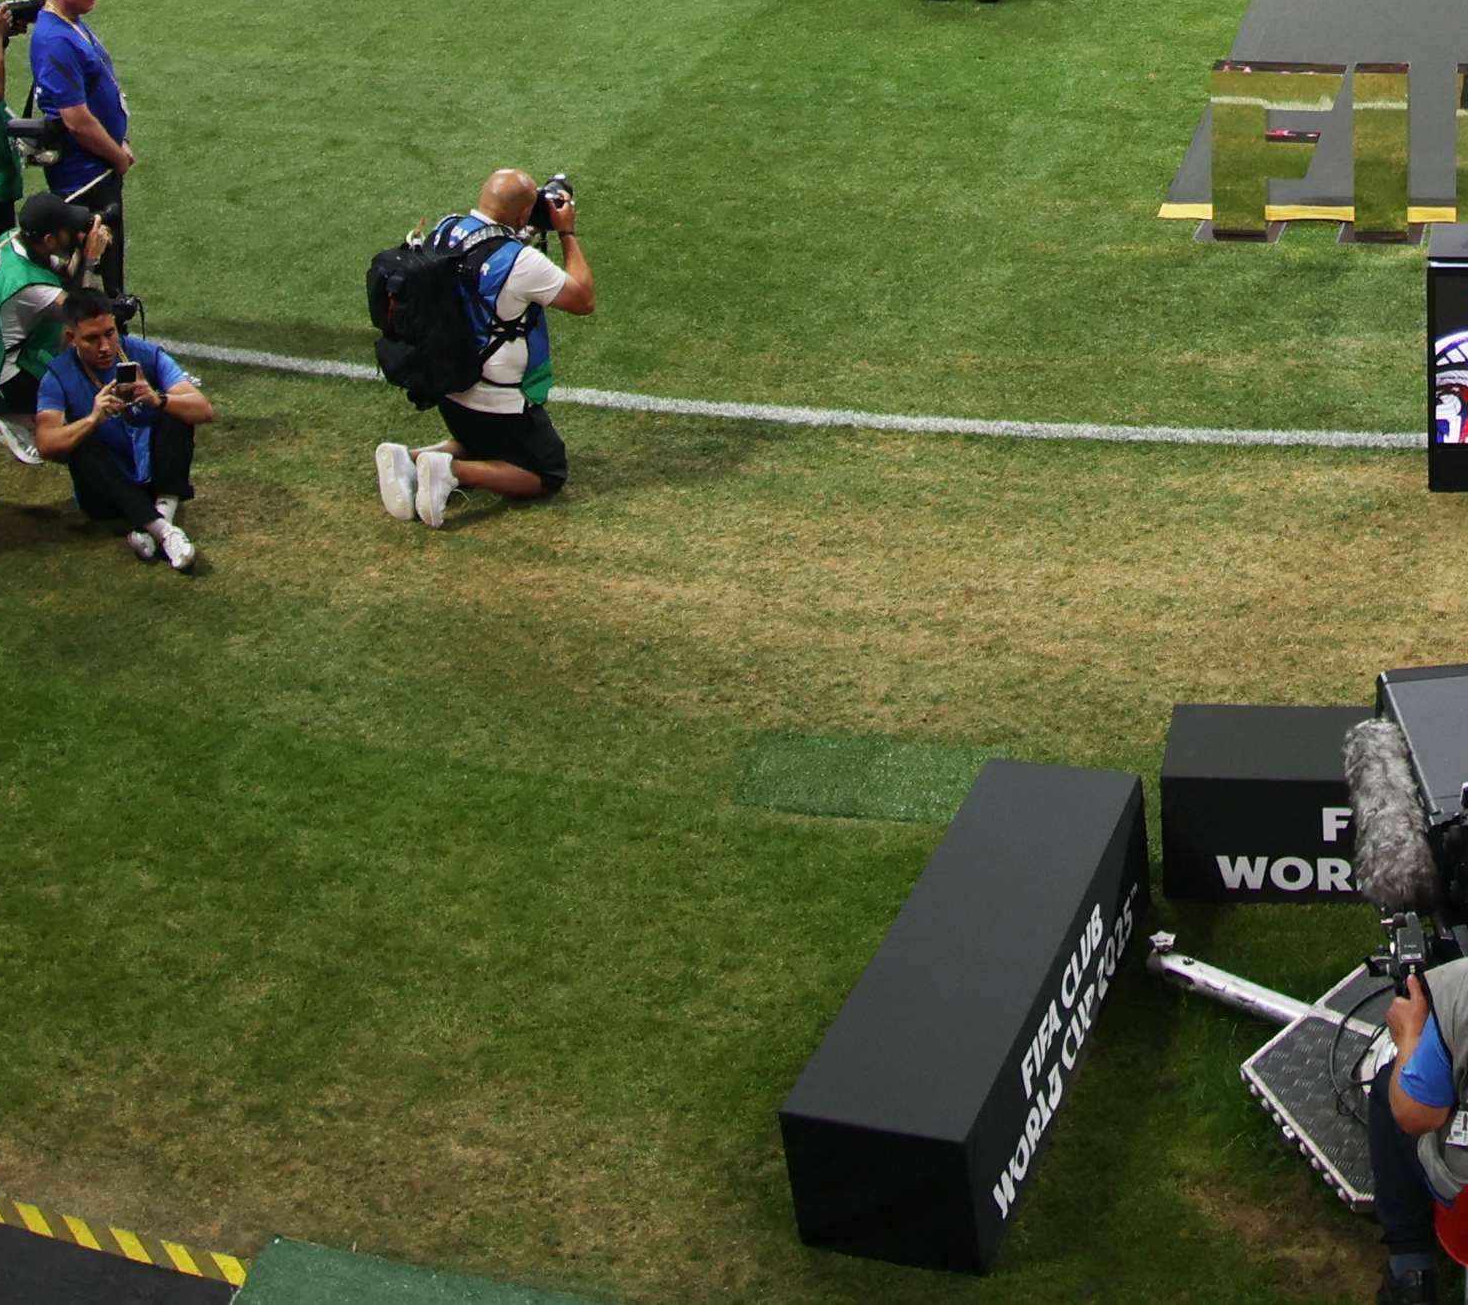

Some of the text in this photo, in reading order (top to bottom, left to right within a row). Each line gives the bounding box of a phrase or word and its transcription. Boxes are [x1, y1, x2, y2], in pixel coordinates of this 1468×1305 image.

[1216, 855, 1355, 892] WOR
[1061, 903, 1103, 1009] CLUB
[1021, 999, 1062, 1100] FIFA
[1062, 983, 1095, 1071] CUP
[993, 1062, 1063, 1220] WORLD
